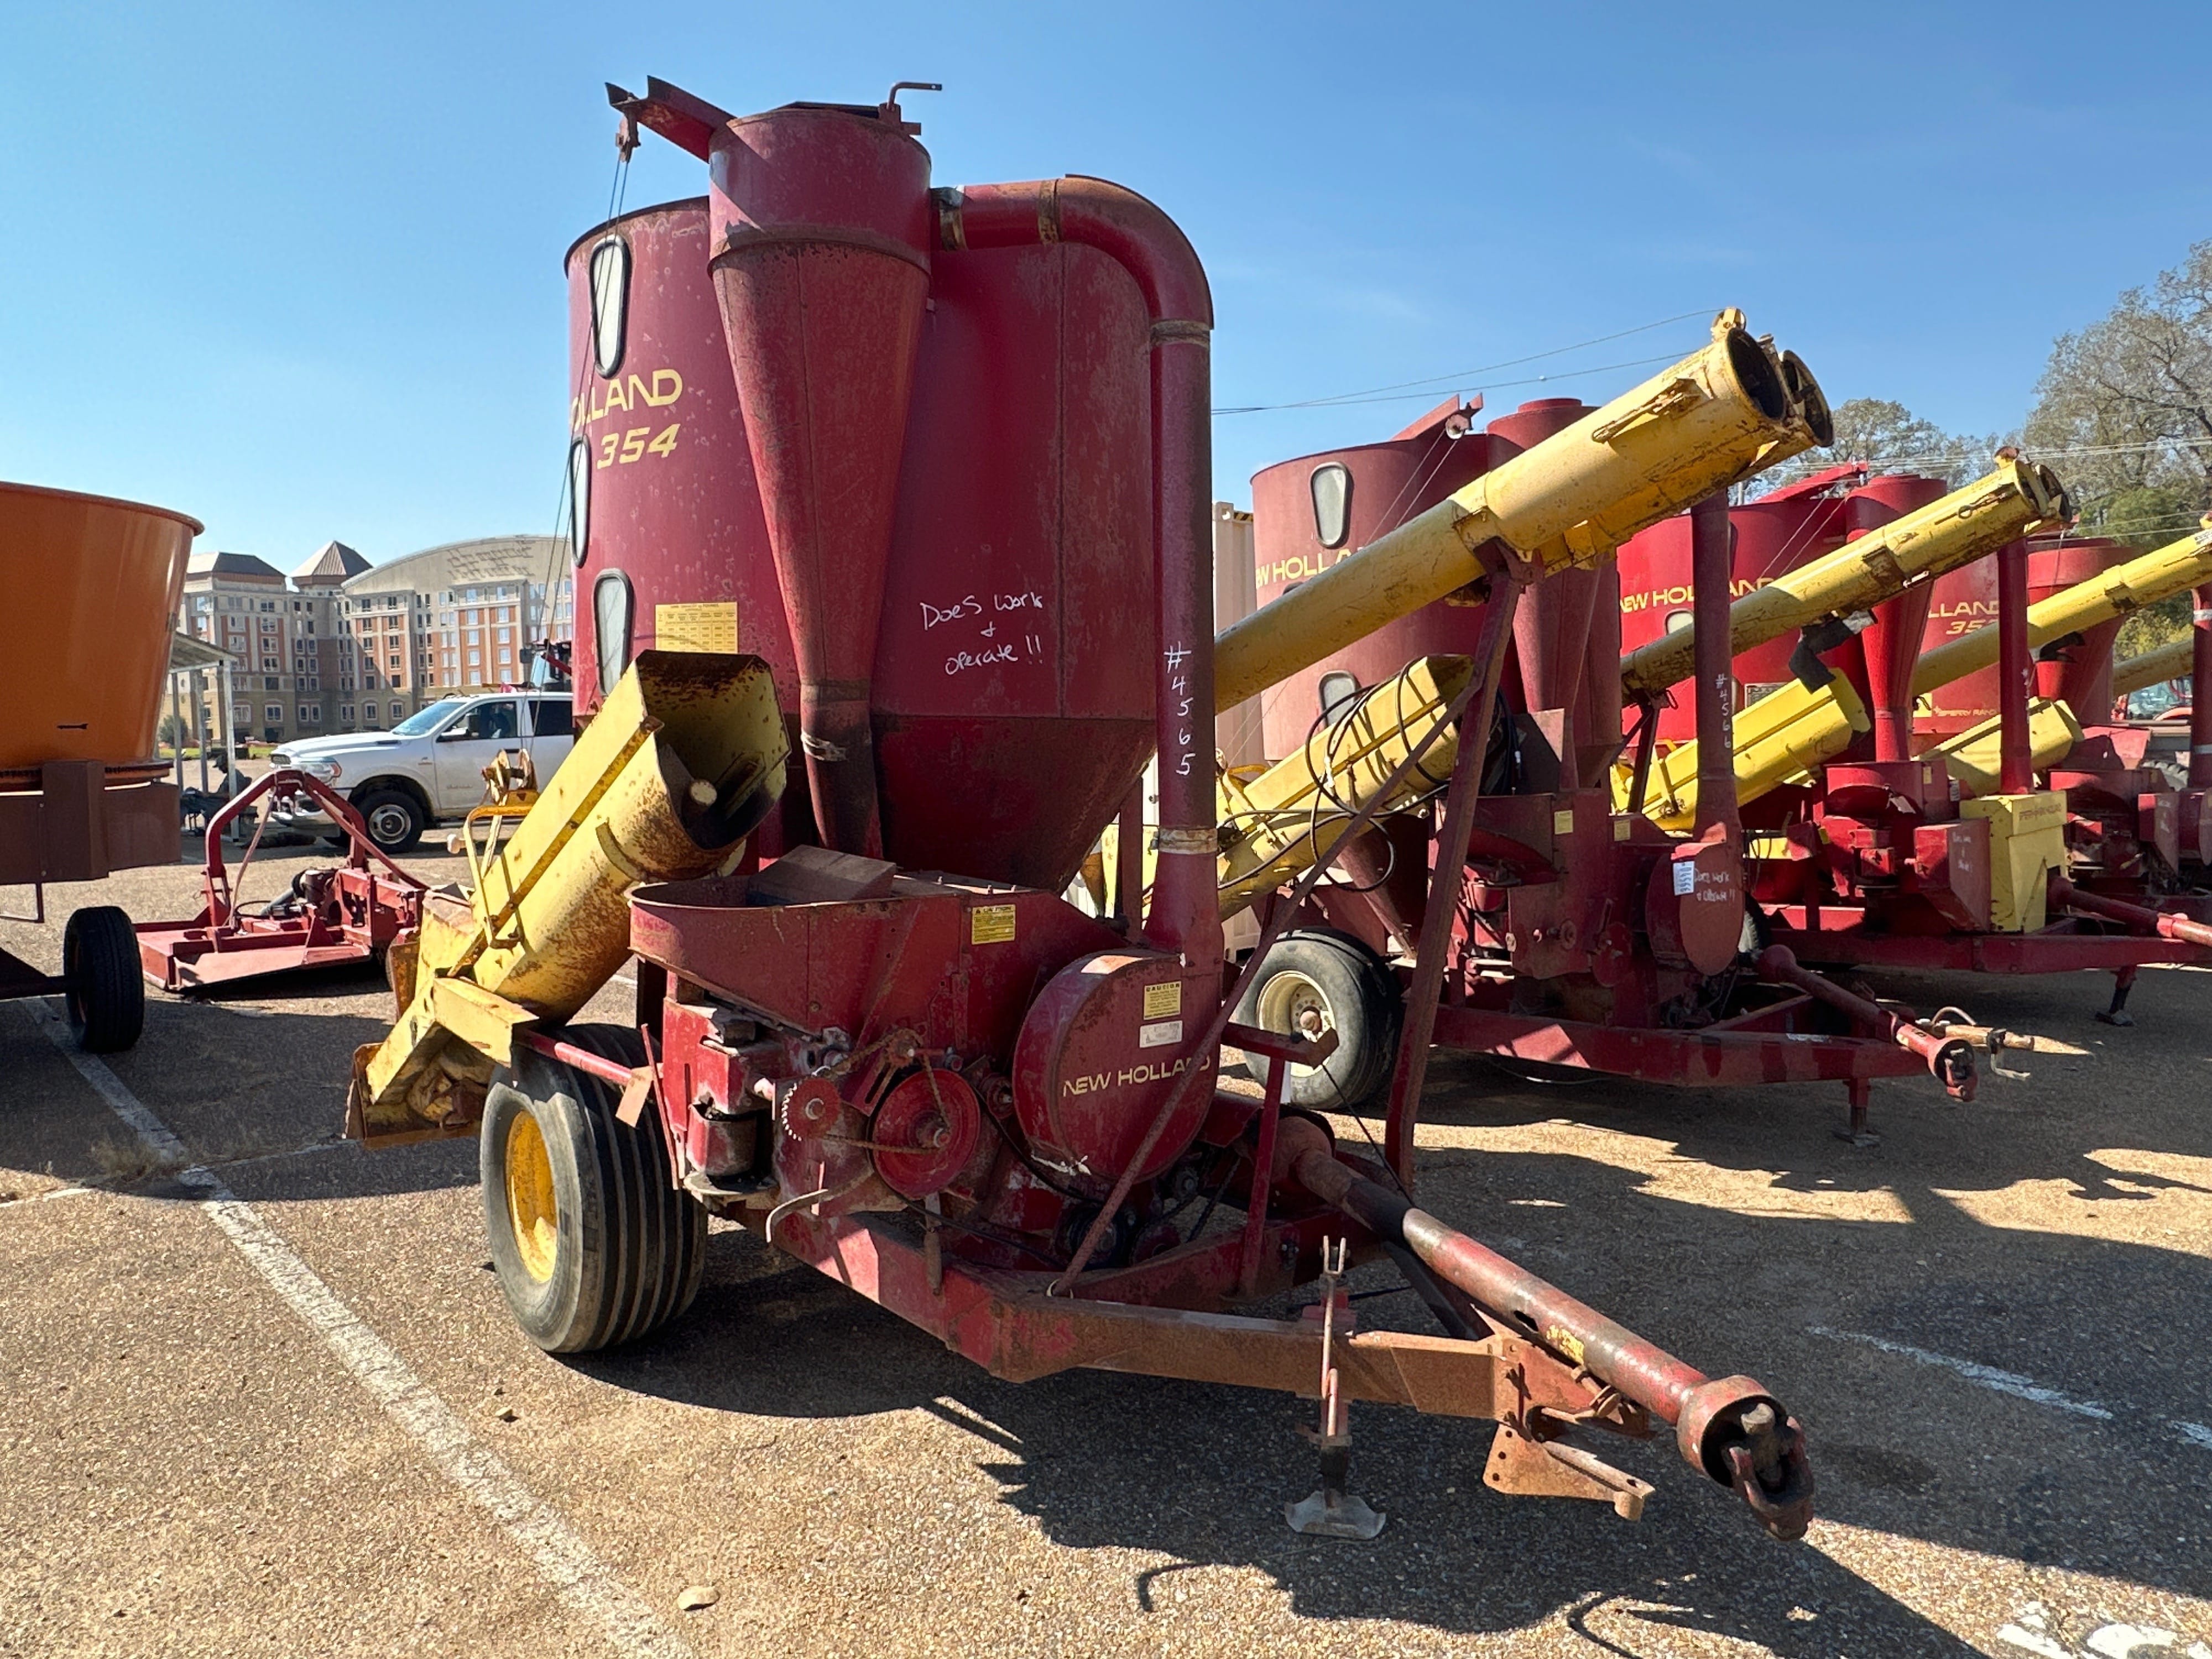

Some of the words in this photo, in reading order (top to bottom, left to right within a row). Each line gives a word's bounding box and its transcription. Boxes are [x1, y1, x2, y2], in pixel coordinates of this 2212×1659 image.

[597, 424, 681, 469] 354
[1945, 619, 1999, 635] 35
[1063, 1072, 1112, 1097] NEW
